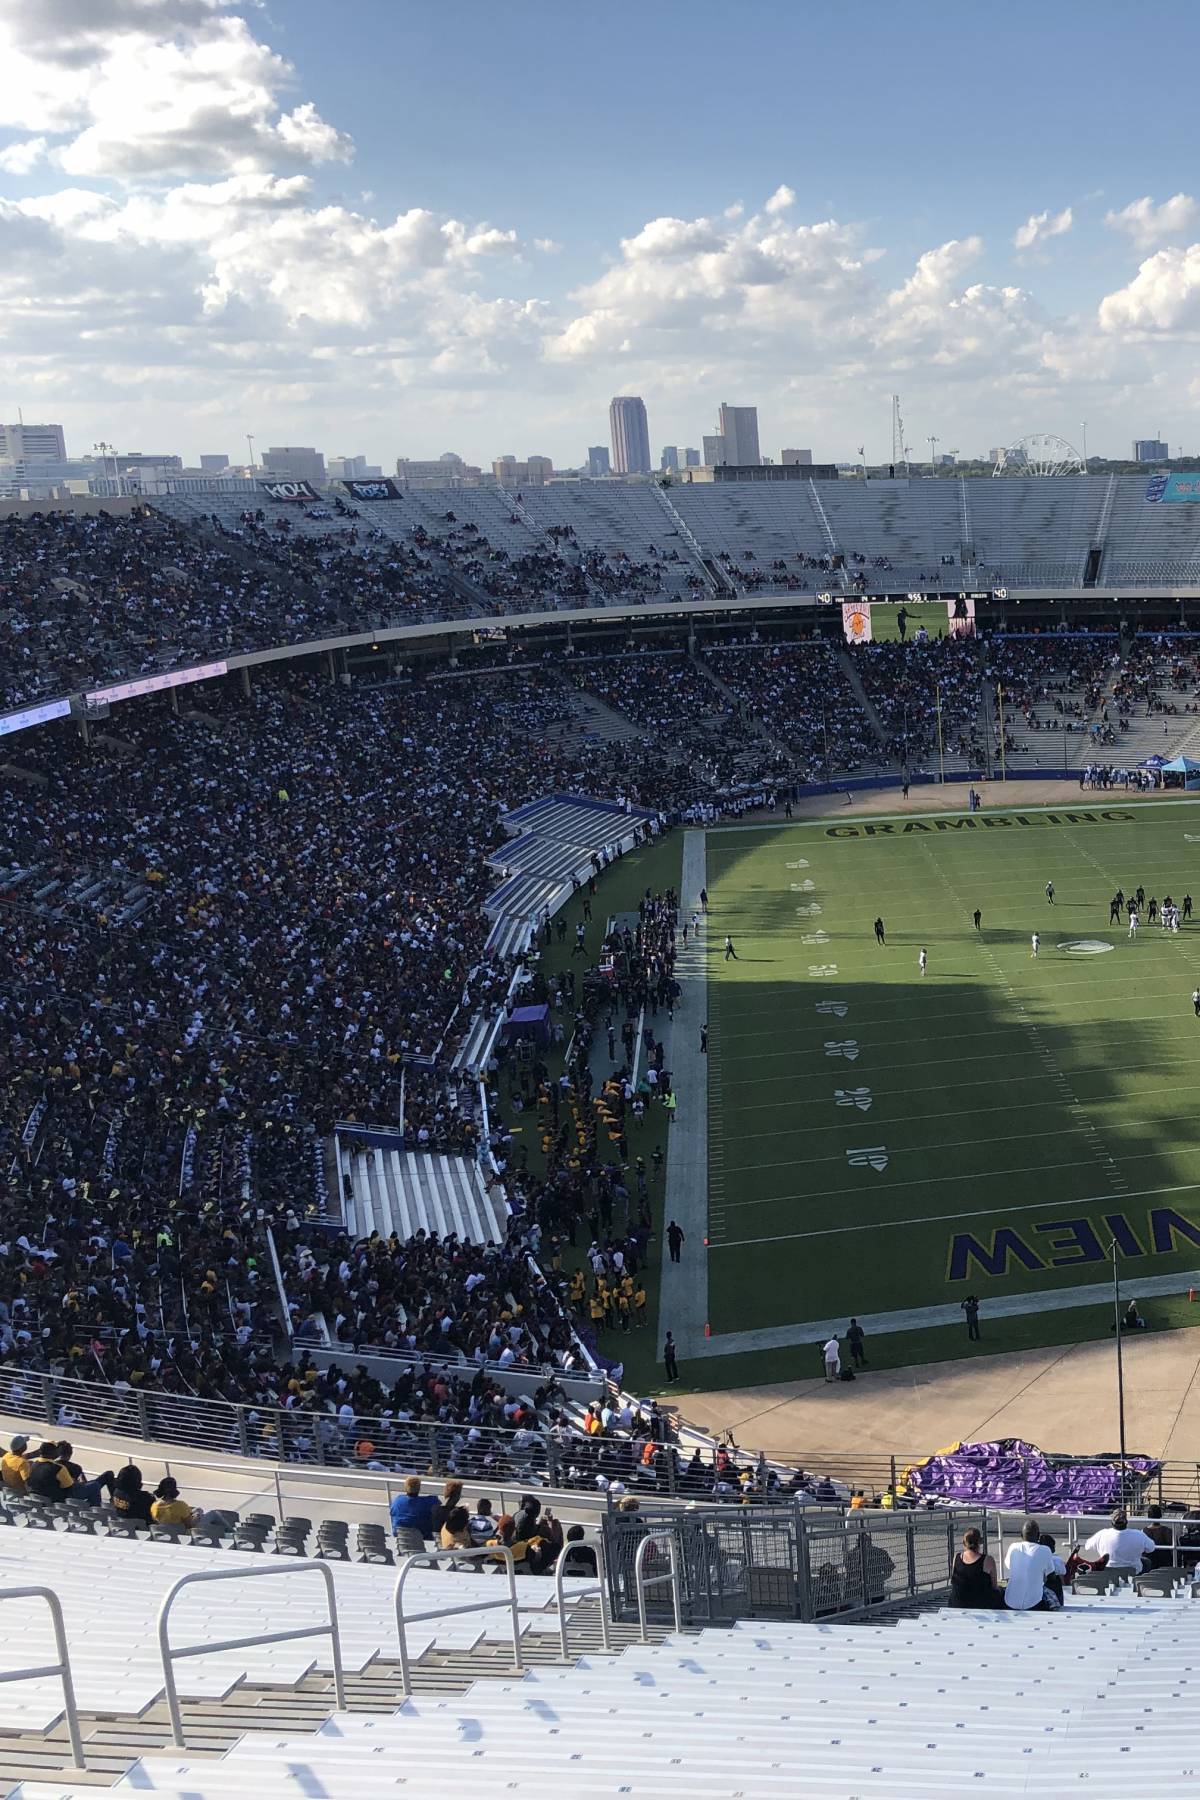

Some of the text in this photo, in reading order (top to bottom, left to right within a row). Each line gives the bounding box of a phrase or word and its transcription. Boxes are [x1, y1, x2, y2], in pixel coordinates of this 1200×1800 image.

[817, 593, 831, 603] 40
[994, 588, 1007, 598] 40
[825, 811, 1136, 838] GRAMBLING
[808, 964, 839, 977] 50
[815, 1000, 849, 1014] 40
[824, 1039, 860, 1056] 30
[834, 1086, 873, 1106] 20
[846, 1145, 889, 1166] 10
